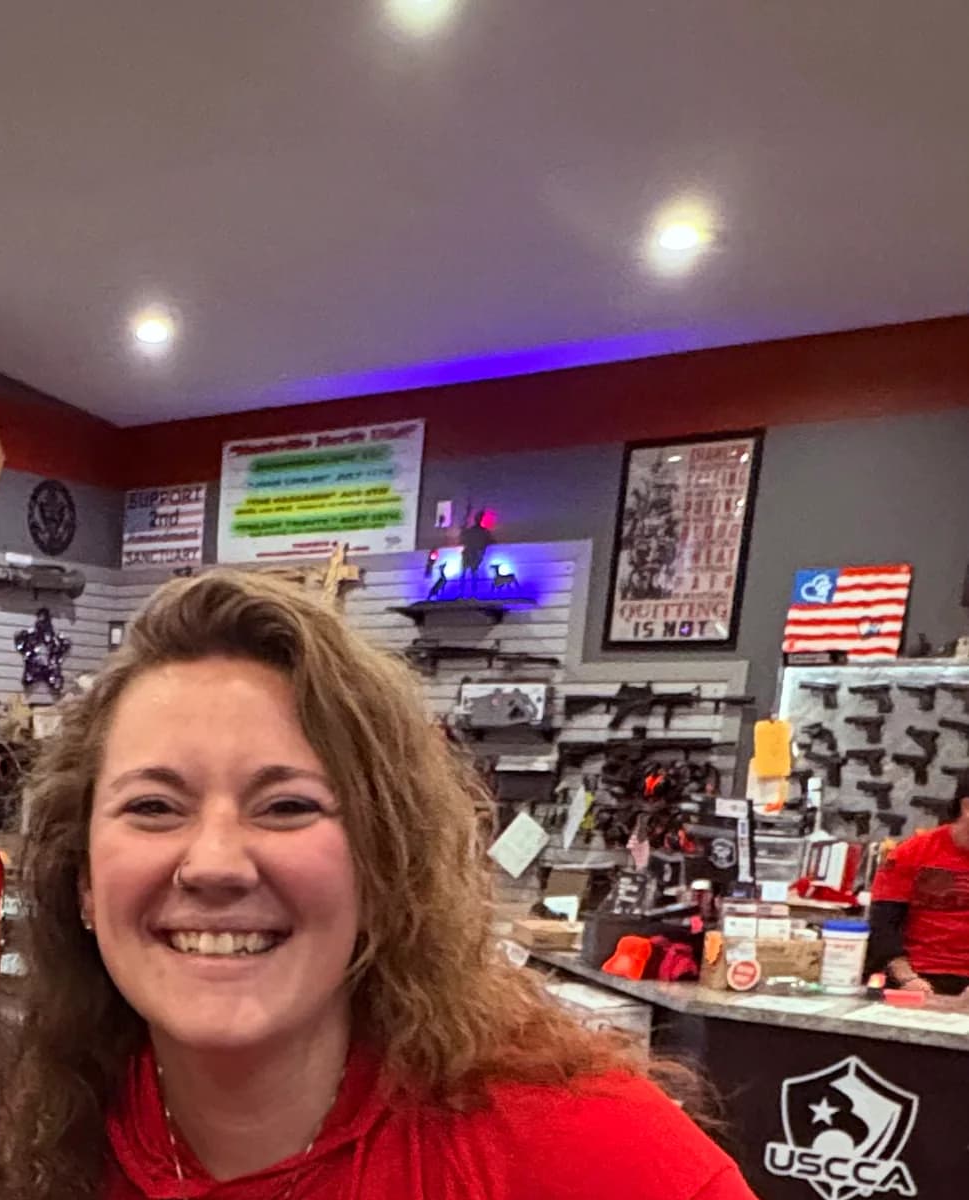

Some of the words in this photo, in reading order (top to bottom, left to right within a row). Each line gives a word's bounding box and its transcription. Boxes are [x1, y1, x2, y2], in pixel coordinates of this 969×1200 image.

[127, 486, 203, 509] SUPPORT
[150, 508, 179, 528] 2nd
[620, 601, 728, 623] QUITTING
[633, 621, 654, 638] IS
[663, 620, 708, 637] NOT
[768, 1146, 912, 1192] USCCA
